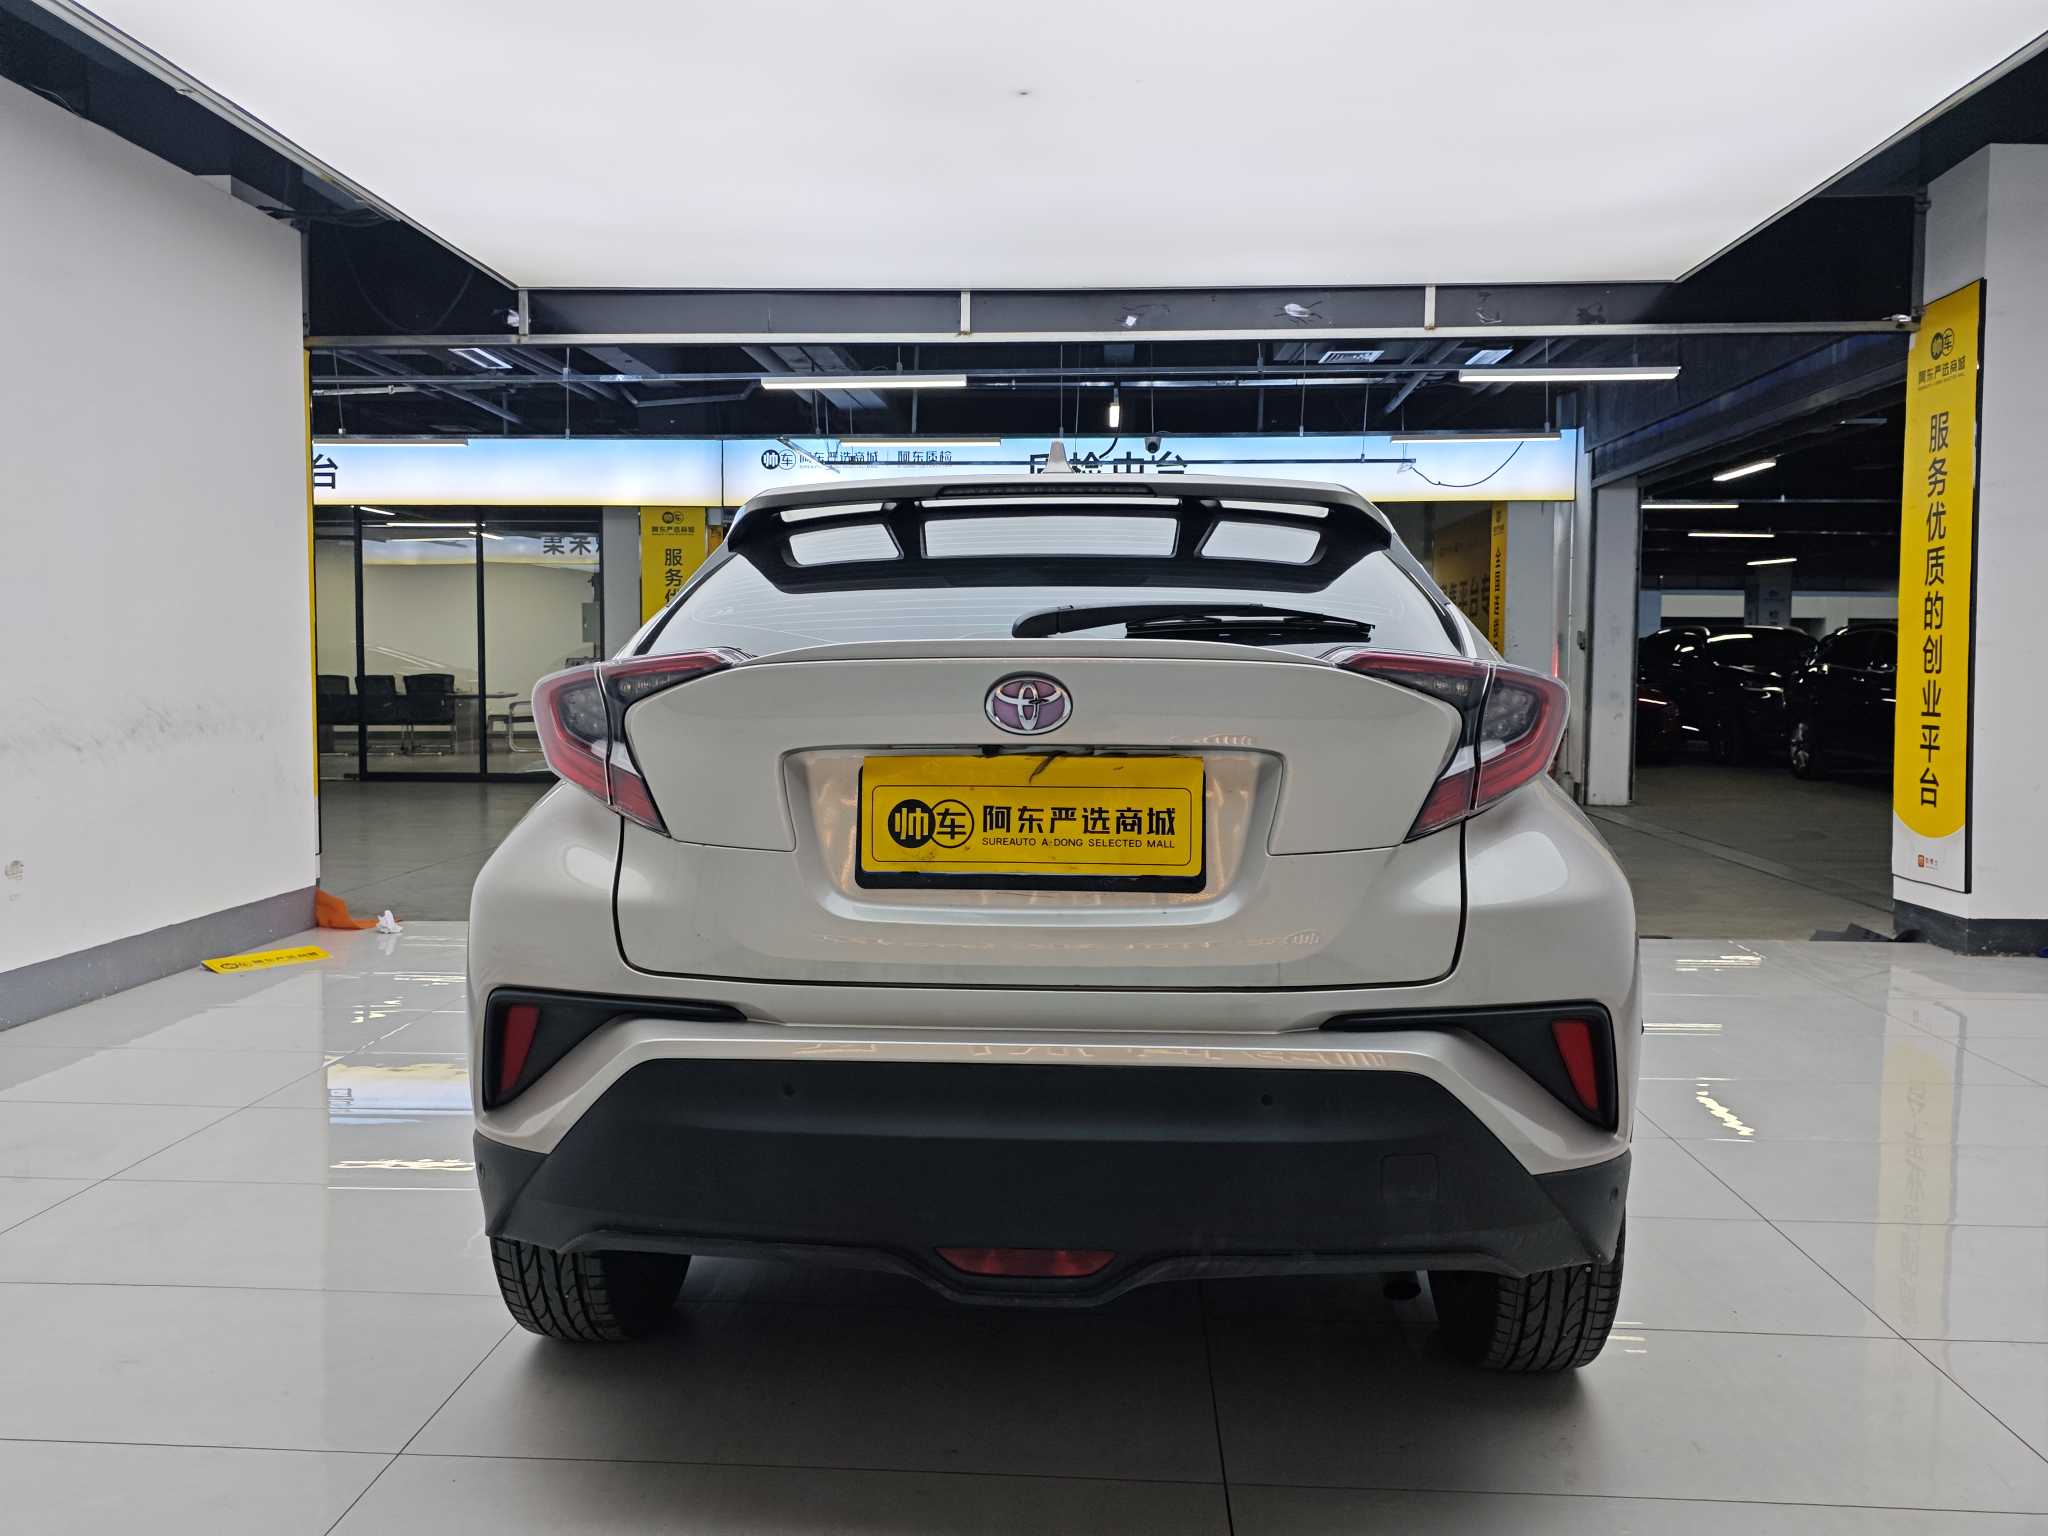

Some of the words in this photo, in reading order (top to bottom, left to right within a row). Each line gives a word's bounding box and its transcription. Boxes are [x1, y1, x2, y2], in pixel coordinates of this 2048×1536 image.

[313, 453, 338, 489] 台
[1920, 410, 1950, 808] 服务优质的创业平台
[891, 803, 970, 844] 帅车
[983, 805, 1176, 836] 阿东严选商城
[982, 837, 1036, 847] SUREAUTO
[1088, 838, 1143, 848] SELECTED
[1146, 839, 1175, 849] MALL
